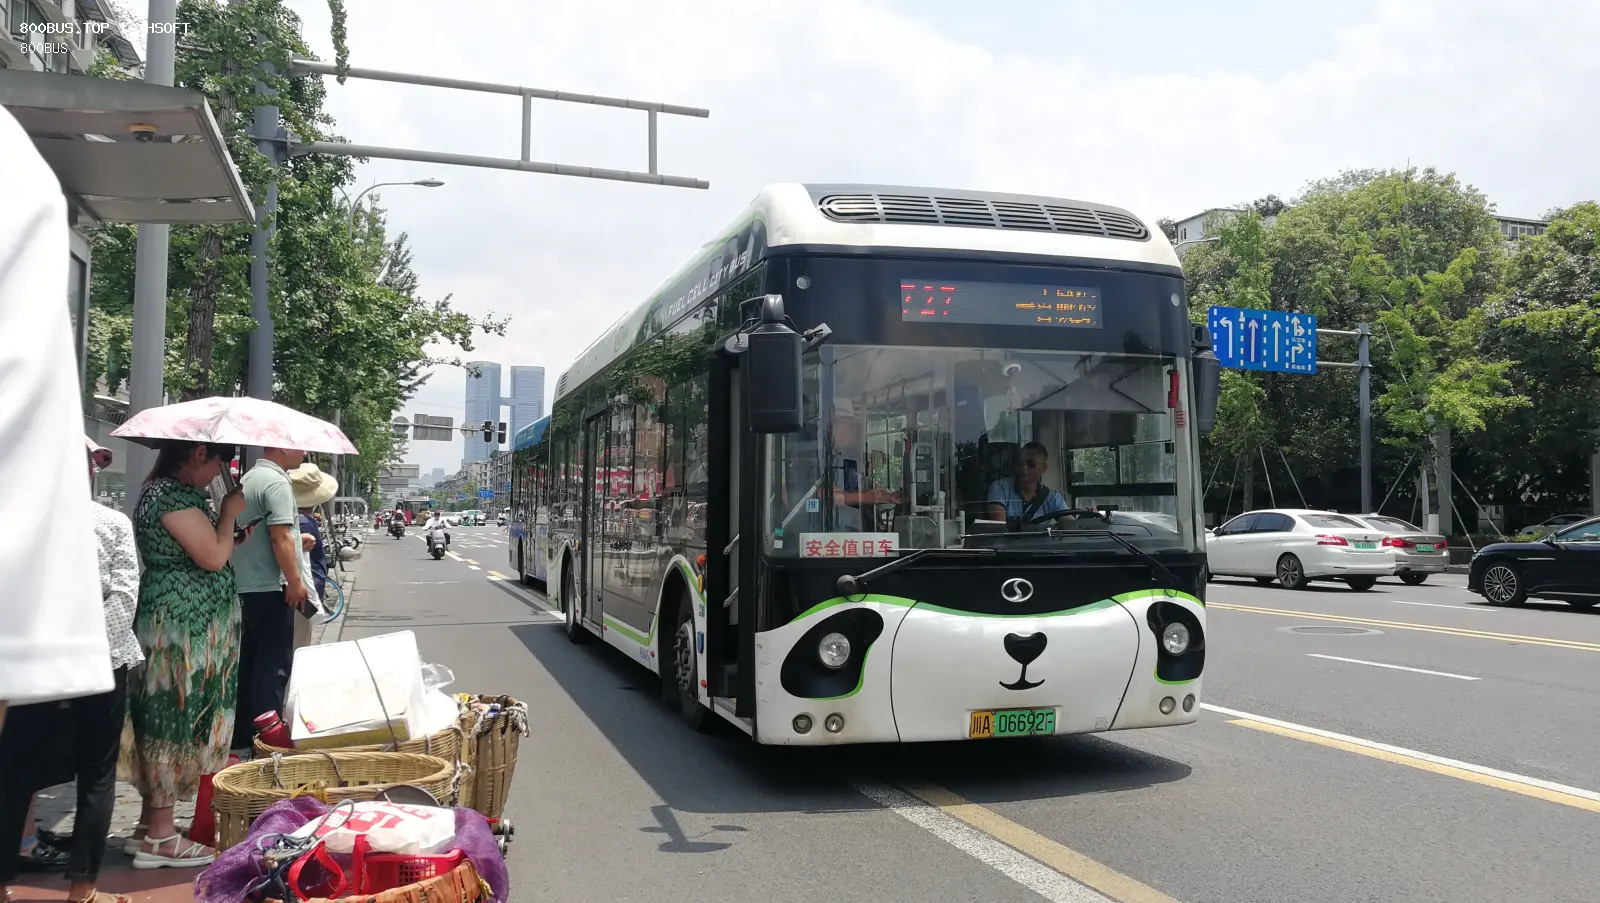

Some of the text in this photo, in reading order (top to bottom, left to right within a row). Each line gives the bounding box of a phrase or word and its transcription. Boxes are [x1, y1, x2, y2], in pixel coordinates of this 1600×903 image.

[668, 296, 686, 316] FUEL
[688, 277, 707, 304] CELL
[805, 539, 893, 556] 安全值日车
[972, 715, 991, 735] 川A
